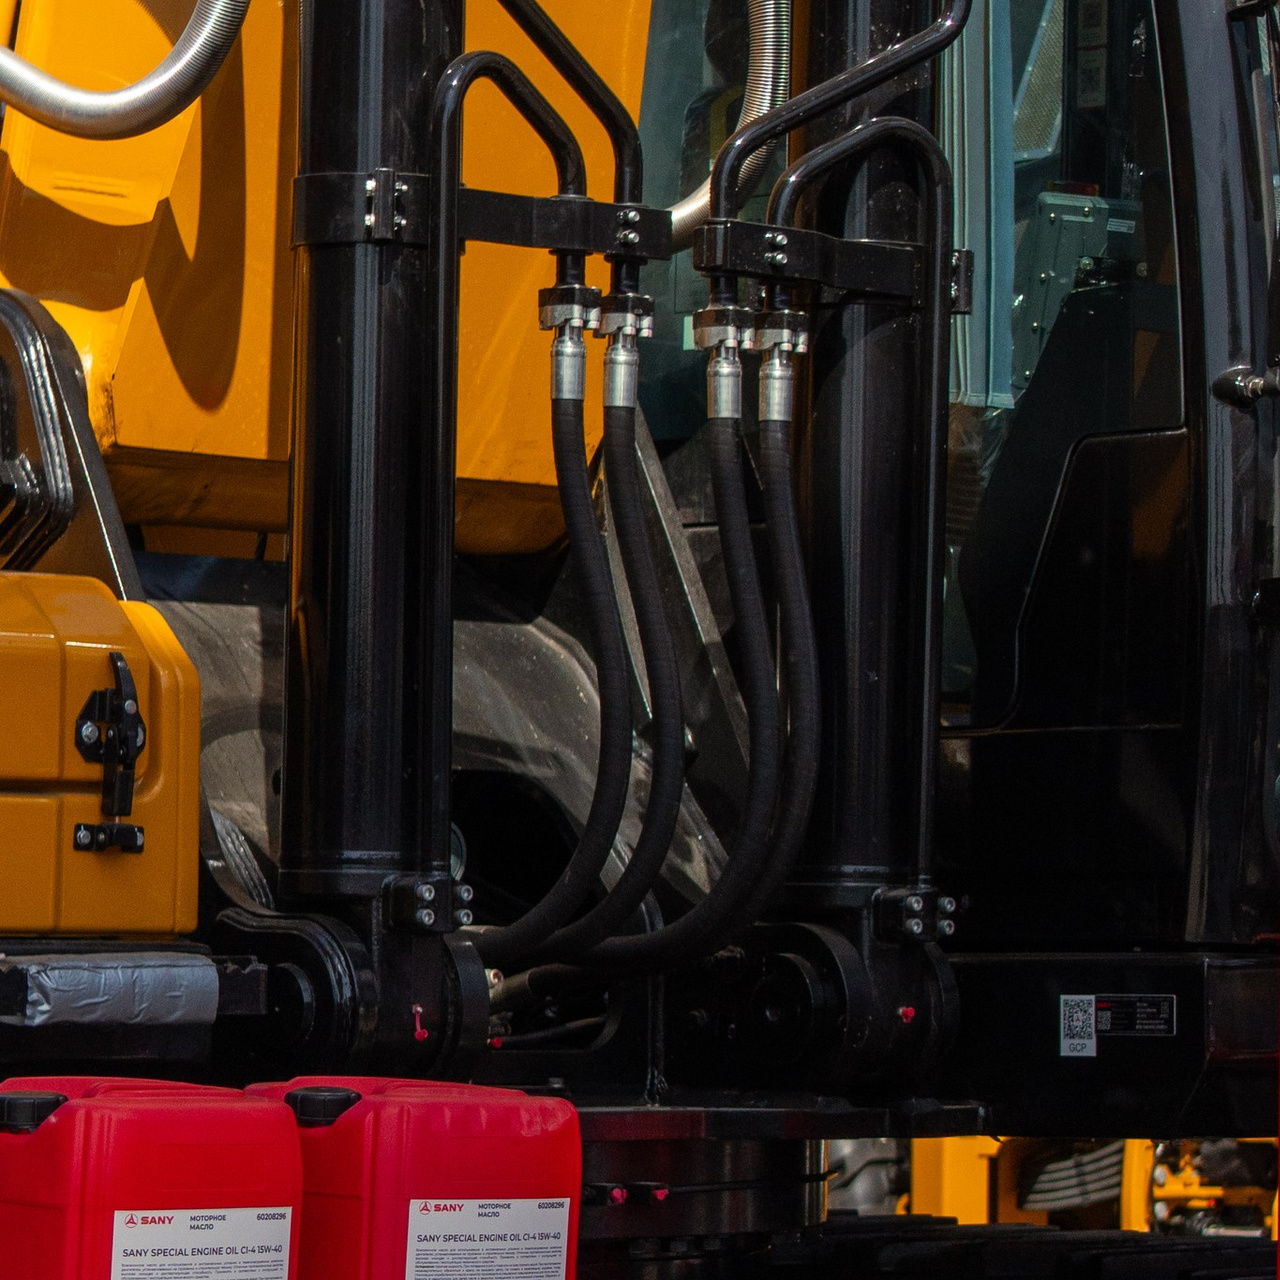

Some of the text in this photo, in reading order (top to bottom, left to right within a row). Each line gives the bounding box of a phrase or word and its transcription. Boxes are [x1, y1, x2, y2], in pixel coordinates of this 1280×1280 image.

[1069, 1043, 1087, 1052] GCP
[140, 1215, 174, 1225] SANY
[189, 1214, 227, 1222] МОТОРНОЕ
[189, 1223, 214, 1231] МАСЛО
[416, 1234, 441, 1243] SANY
[442, 1233, 478, 1243] SPECIAL
[478, 1233, 508, 1242] ENGINE
[509, 1233, 522, 1242] OIL
[122, 1248, 149, 1258] SANY
[150, 1247, 189, 1257] SPECIAL
[191, 1246, 224, 1257] ENGINE
[225, 1245, 239, 1255] OIL
[257, 1244, 283, 1253] 15W-40
